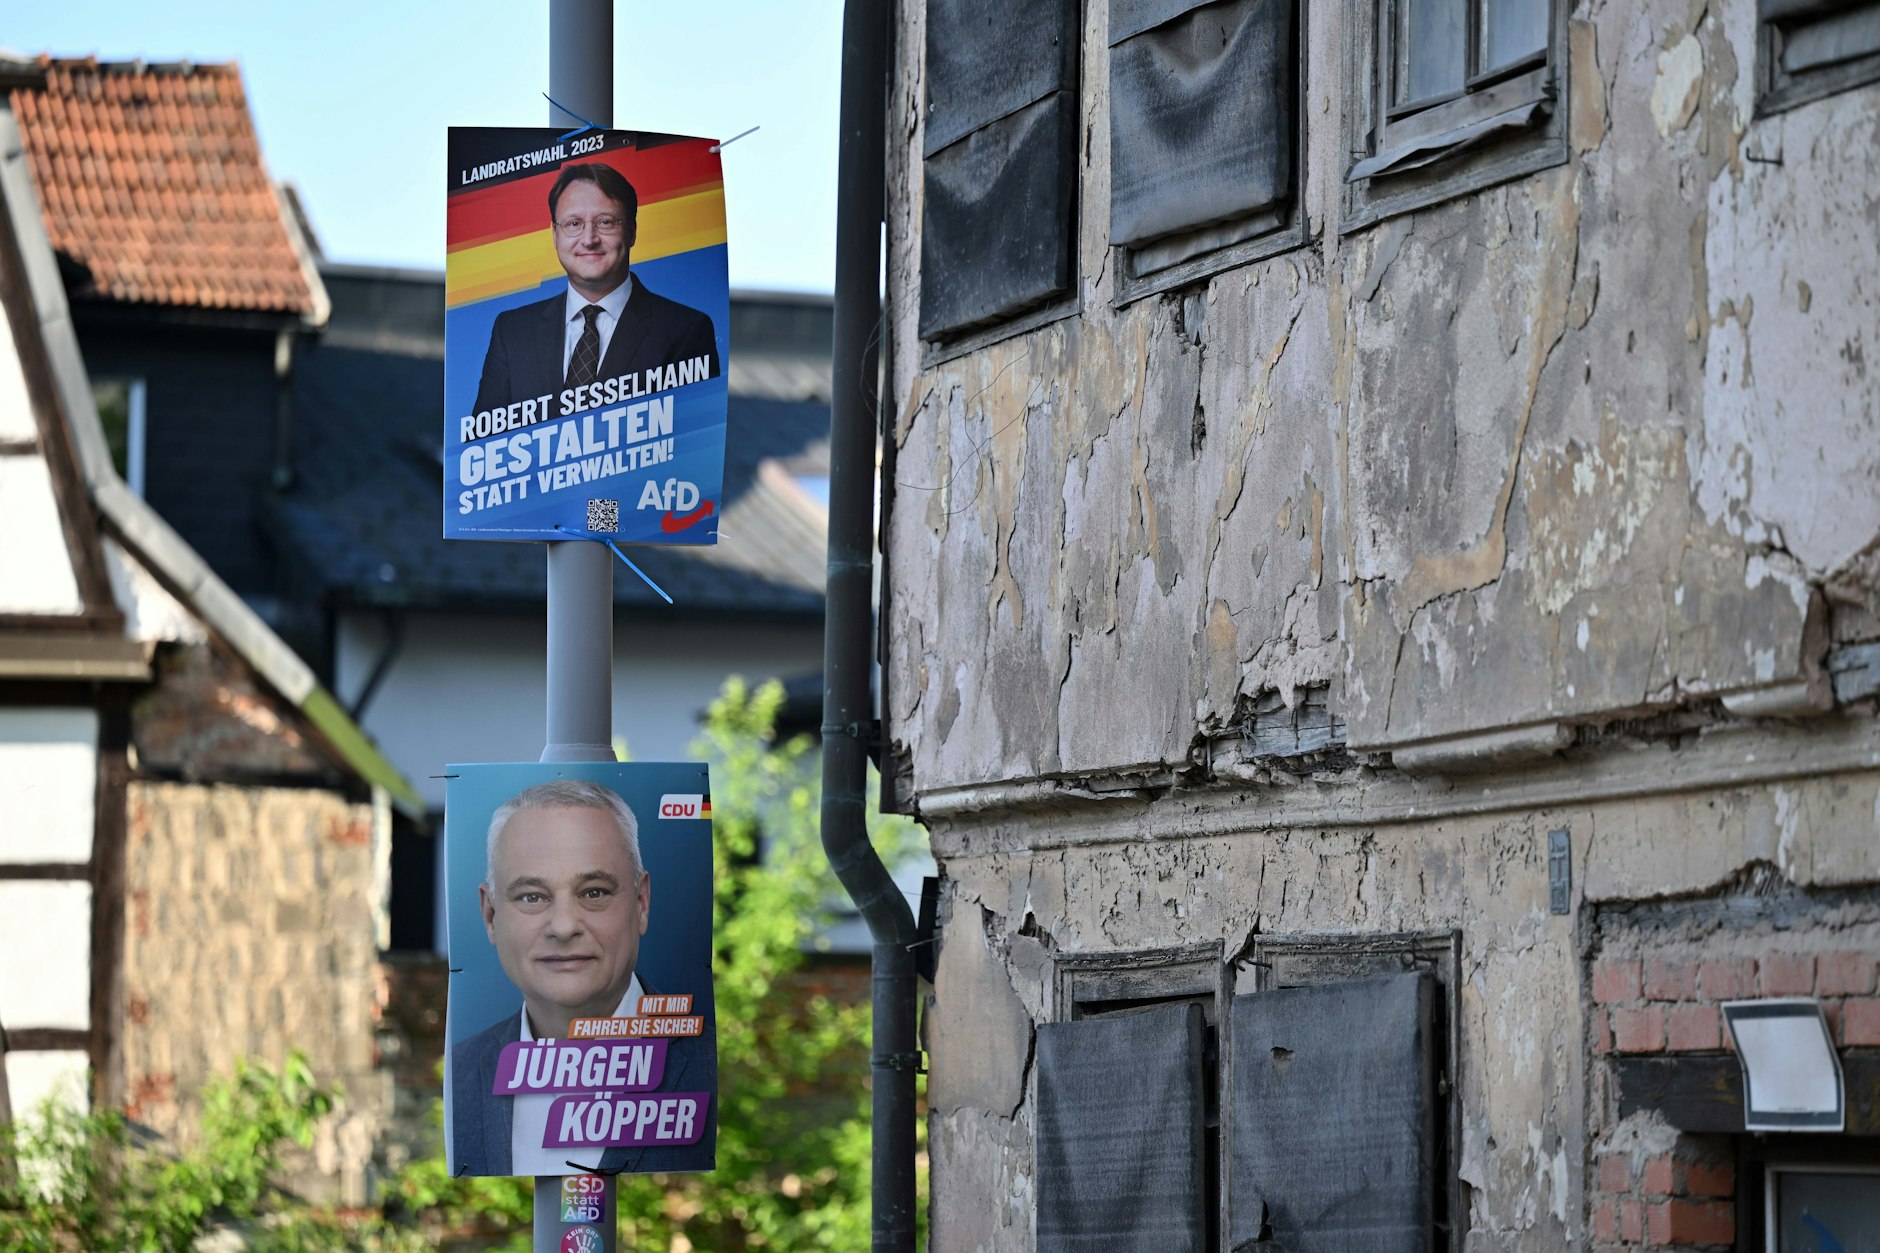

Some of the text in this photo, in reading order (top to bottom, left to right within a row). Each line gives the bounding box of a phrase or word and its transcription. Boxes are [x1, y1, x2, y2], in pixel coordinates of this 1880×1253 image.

[462, 134, 605, 185] LANDRATSWAHL 2023
[460, 354, 710, 443] ROBERT SESSELMANN
[459, 395, 674, 487] GESTALTEN
[459, 437, 674, 515] STATT VERWALTEN!
[636, 477, 700, 512] AfD
[661, 803, 695, 817] CDU
[641, 995, 689, 1013] MIT MIR
[573, 1017, 699, 1036] FAHREN SIE SICHER!
[508, 1038, 654, 1089] JÜRGEN
[558, 1091, 697, 1142] KÖPPER
[563, 1176, 605, 1193] CSD
[565, 1194, 600, 1205] statt
[563, 1206, 600, 1221] AFD
[565, 1228, 599, 1241] KEIN ORT
